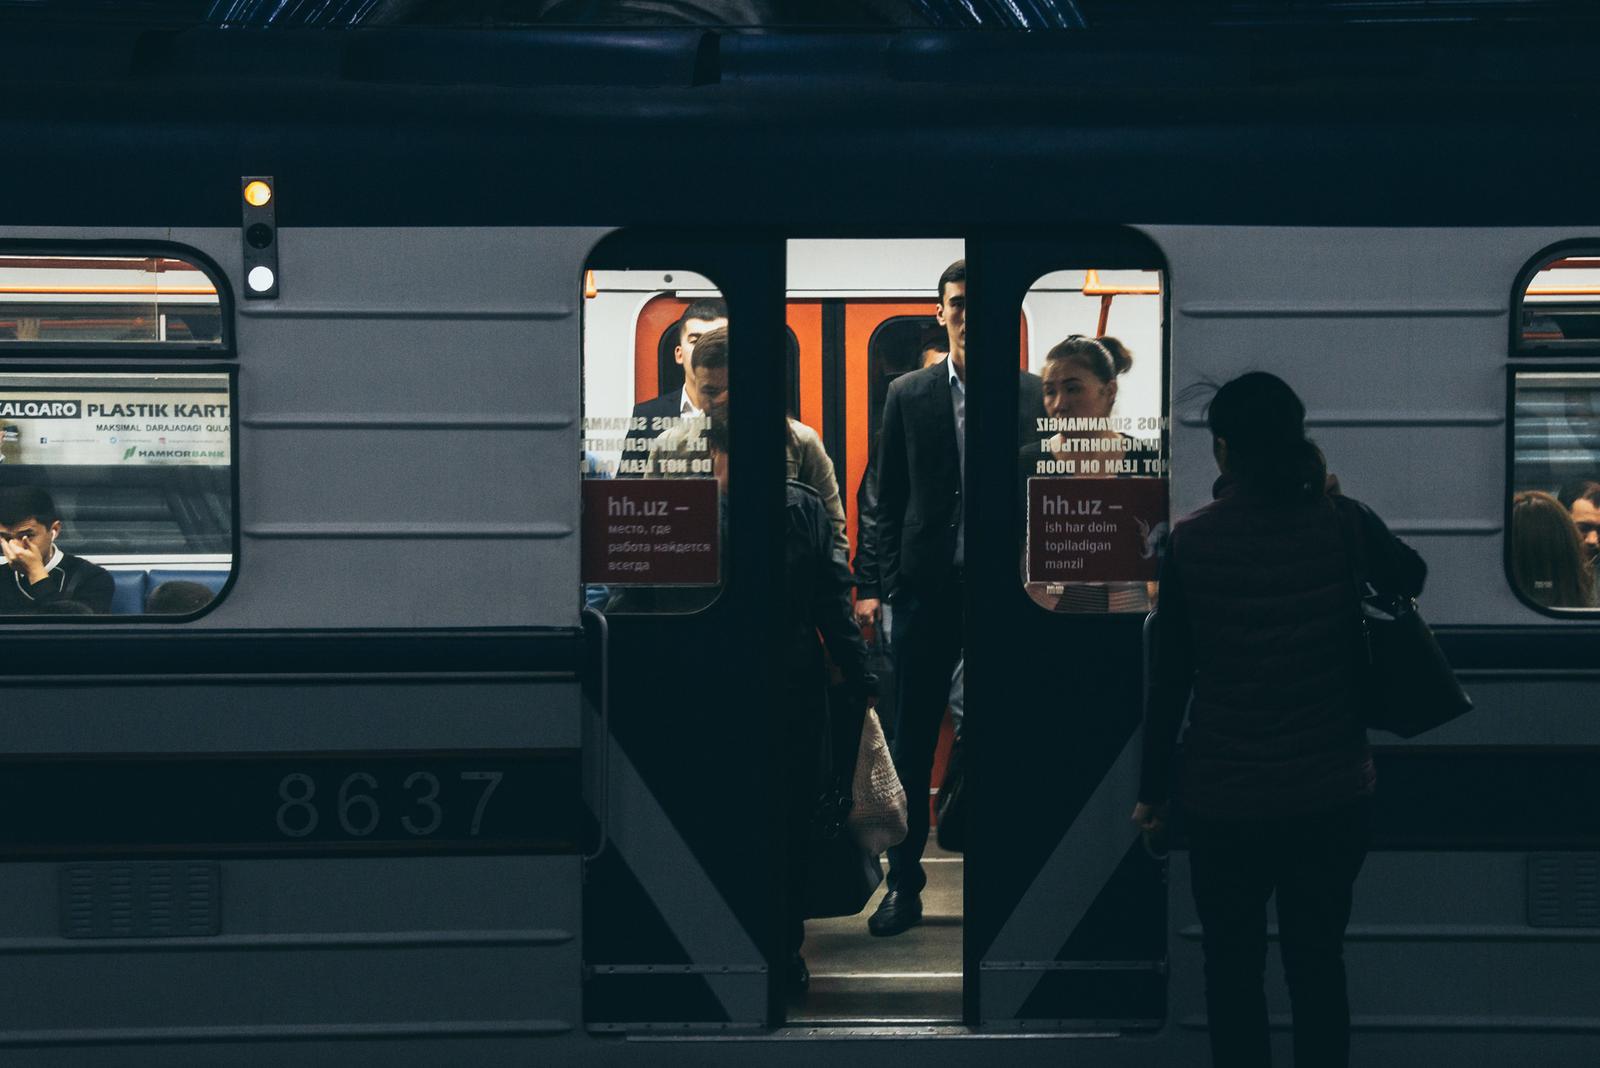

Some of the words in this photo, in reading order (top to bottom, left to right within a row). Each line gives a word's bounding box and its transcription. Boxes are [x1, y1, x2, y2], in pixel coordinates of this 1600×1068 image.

[0, 402, 78, 417] ALQARO
[87, 403, 168, 418] PLASTIK
[174, 403, 230, 418] KART
[96, 424, 141, 432] MAKSIMAL
[146, 424, 202, 432] DARAJADAGI
[138, 450, 225, 458] HAMKORBANK
[608, 496, 668, 517] hh.uz
[1042, 496, 1102, 516] hh.uz
[608, 525, 648, 536] место,
[651, 525, 672, 536] где
[1045, 521, 1063, 533] ish
[1065, 521, 1084, 533] har
[1088, 521, 1117, 533] doim
[608, 541, 650, 554] работа
[653, 541, 712, 553] найдется
[1045, 540, 1111, 554] topiladigan
[608, 561, 651, 572] всегда
[1045, 557, 1084, 569] manzil
[275, 771, 504, 838] 8637
